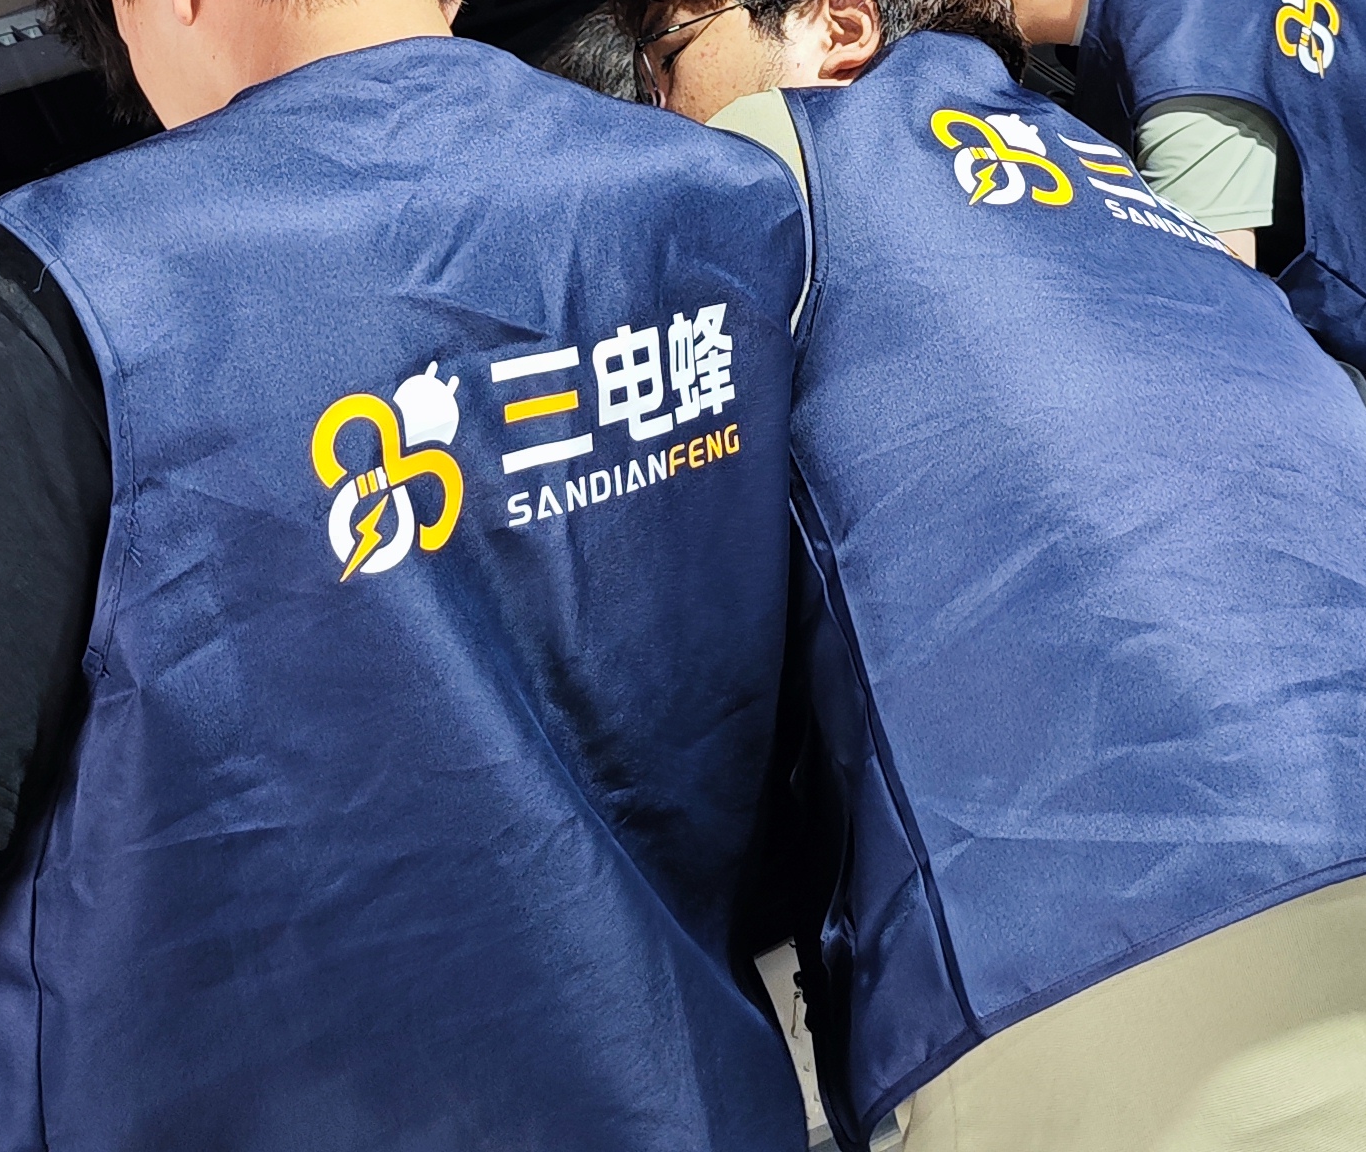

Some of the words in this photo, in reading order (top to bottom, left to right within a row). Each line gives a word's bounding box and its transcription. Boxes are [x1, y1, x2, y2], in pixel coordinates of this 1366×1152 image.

[1104, 198, 1239, 258] SANDIAN
[490, 302, 736, 474] 三电蜂
[506, 424, 741, 527] SANDIANFENG
